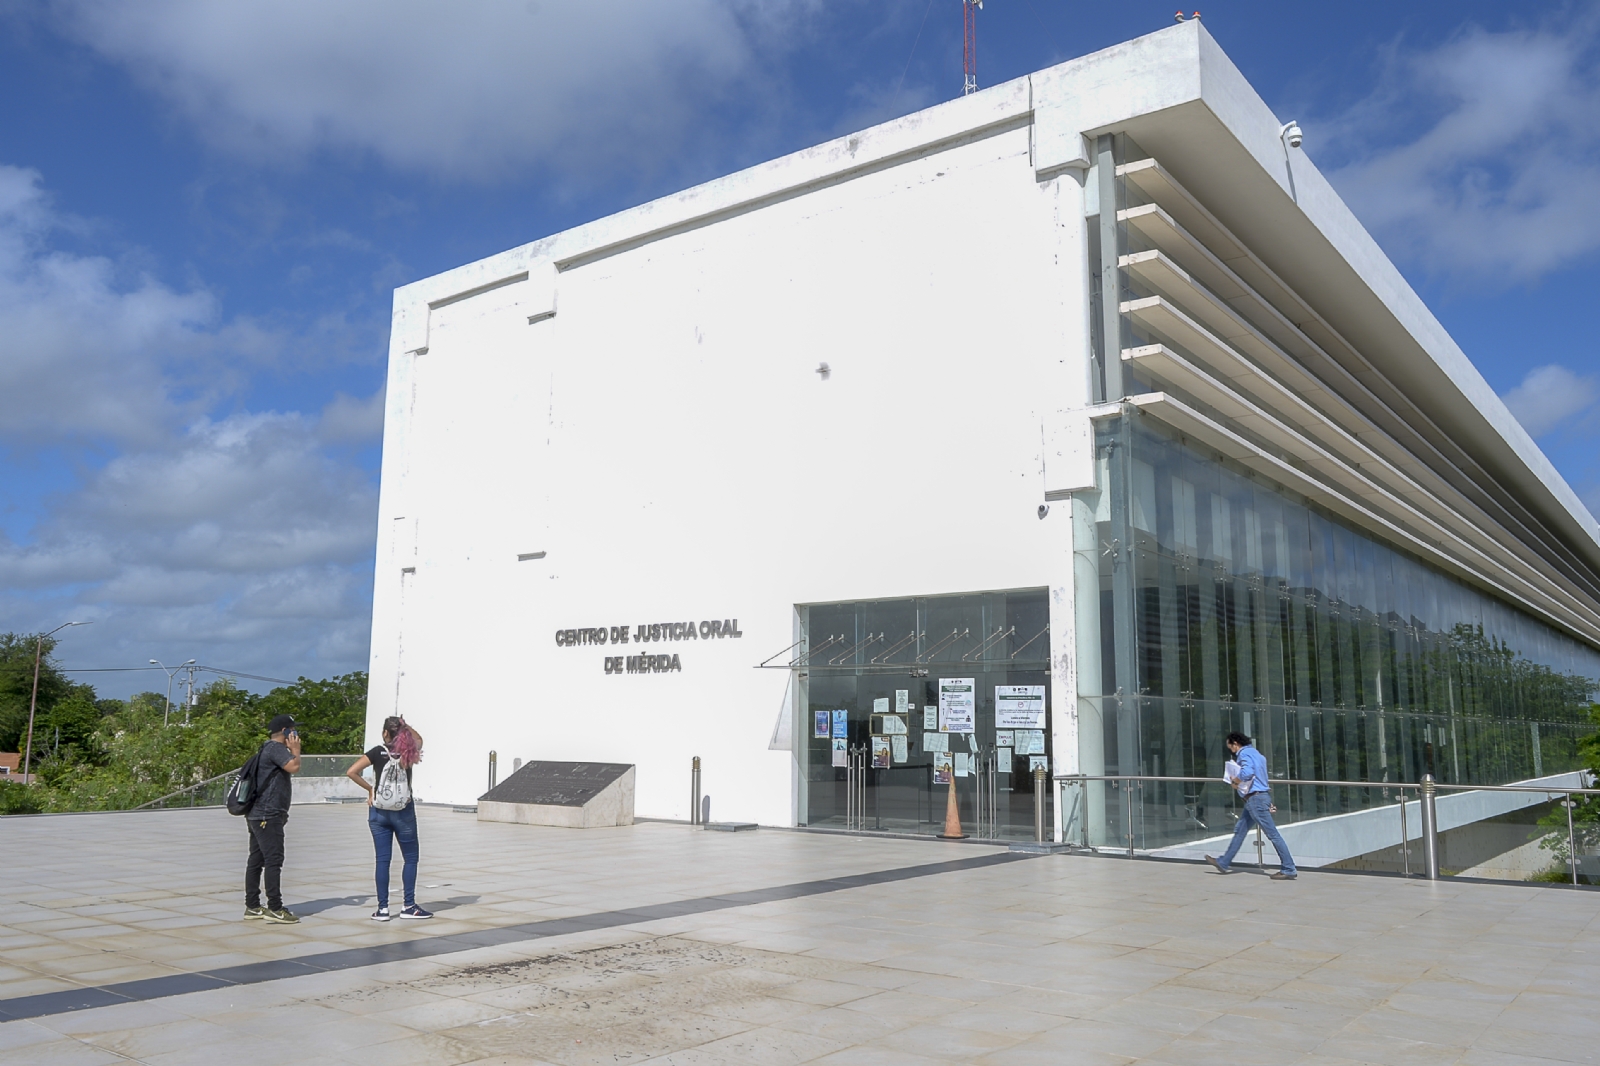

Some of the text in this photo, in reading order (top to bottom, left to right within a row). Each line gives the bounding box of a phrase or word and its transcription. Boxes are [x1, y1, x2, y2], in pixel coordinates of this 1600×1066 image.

[555, 618, 743, 647] CENTRO DE JUSTICIA ORAL
[604, 651, 682, 675] DE MÉRIDA
